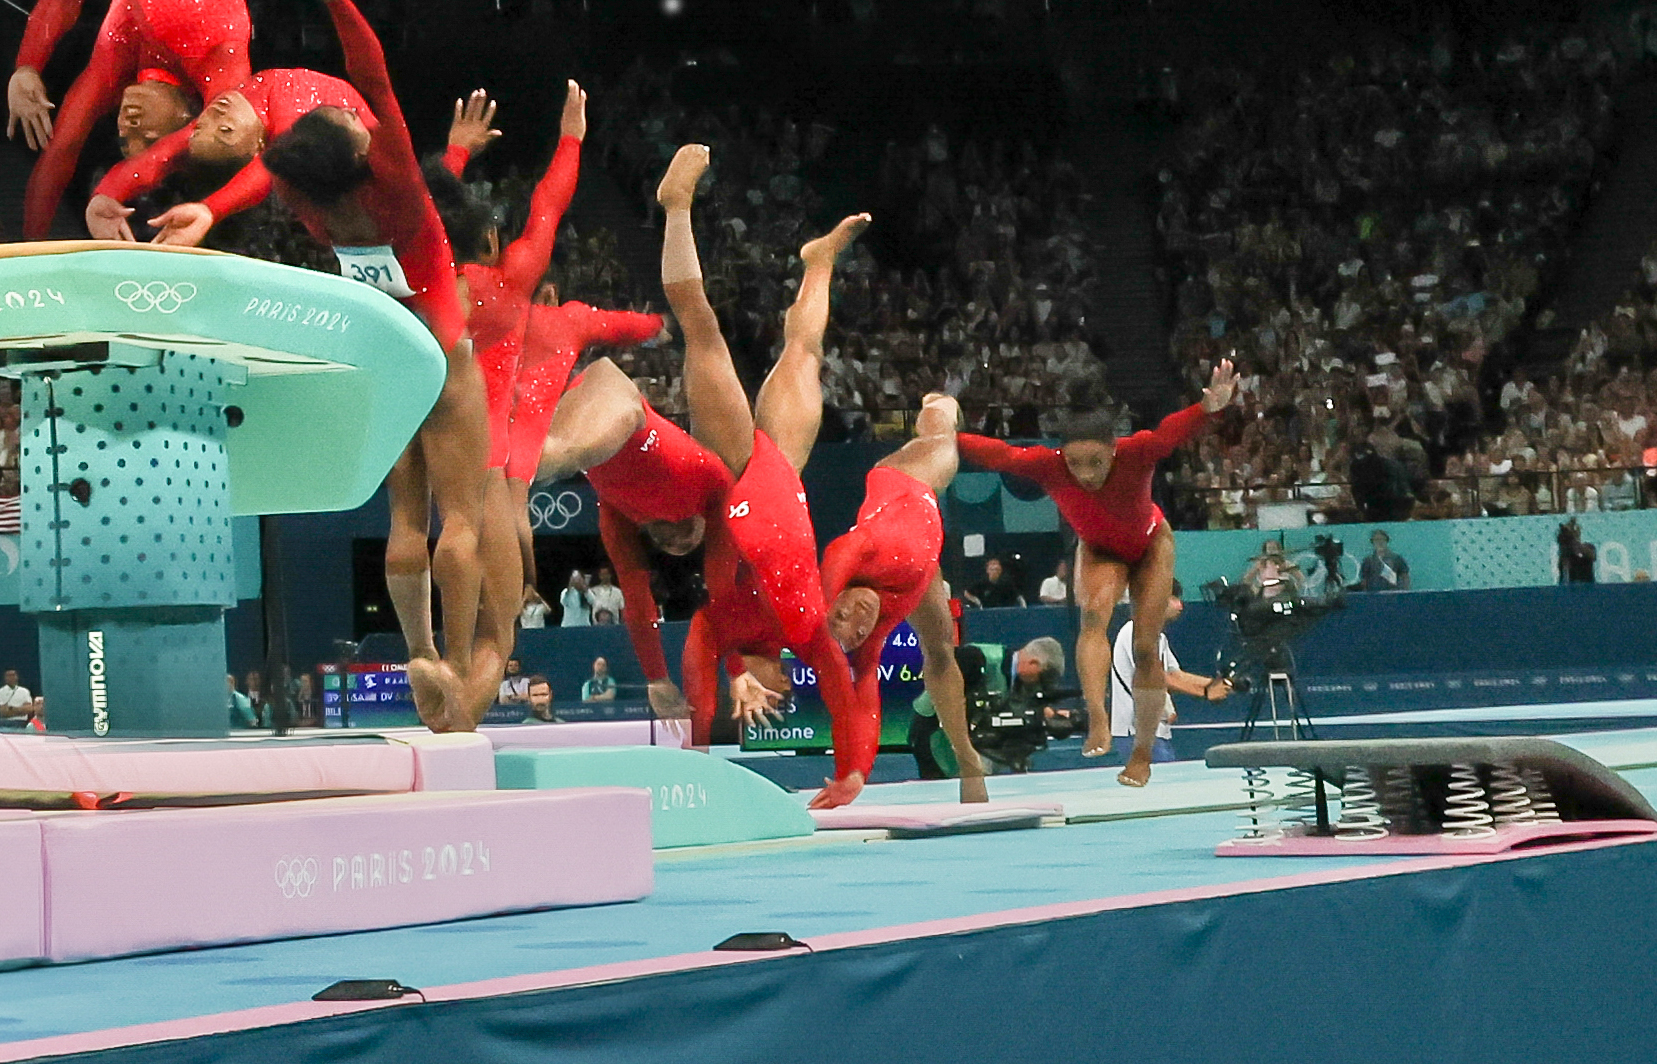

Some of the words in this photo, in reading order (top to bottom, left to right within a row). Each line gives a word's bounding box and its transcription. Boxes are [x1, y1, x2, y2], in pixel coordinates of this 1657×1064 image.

[350, 263, 393, 284] 391
[301, 307, 352, 333] 2024
[793, 667, 817, 686] US
[747, 725, 815, 741] Simone
[659, 783, 707, 811] 2024
[421, 840, 491, 881] 2024
